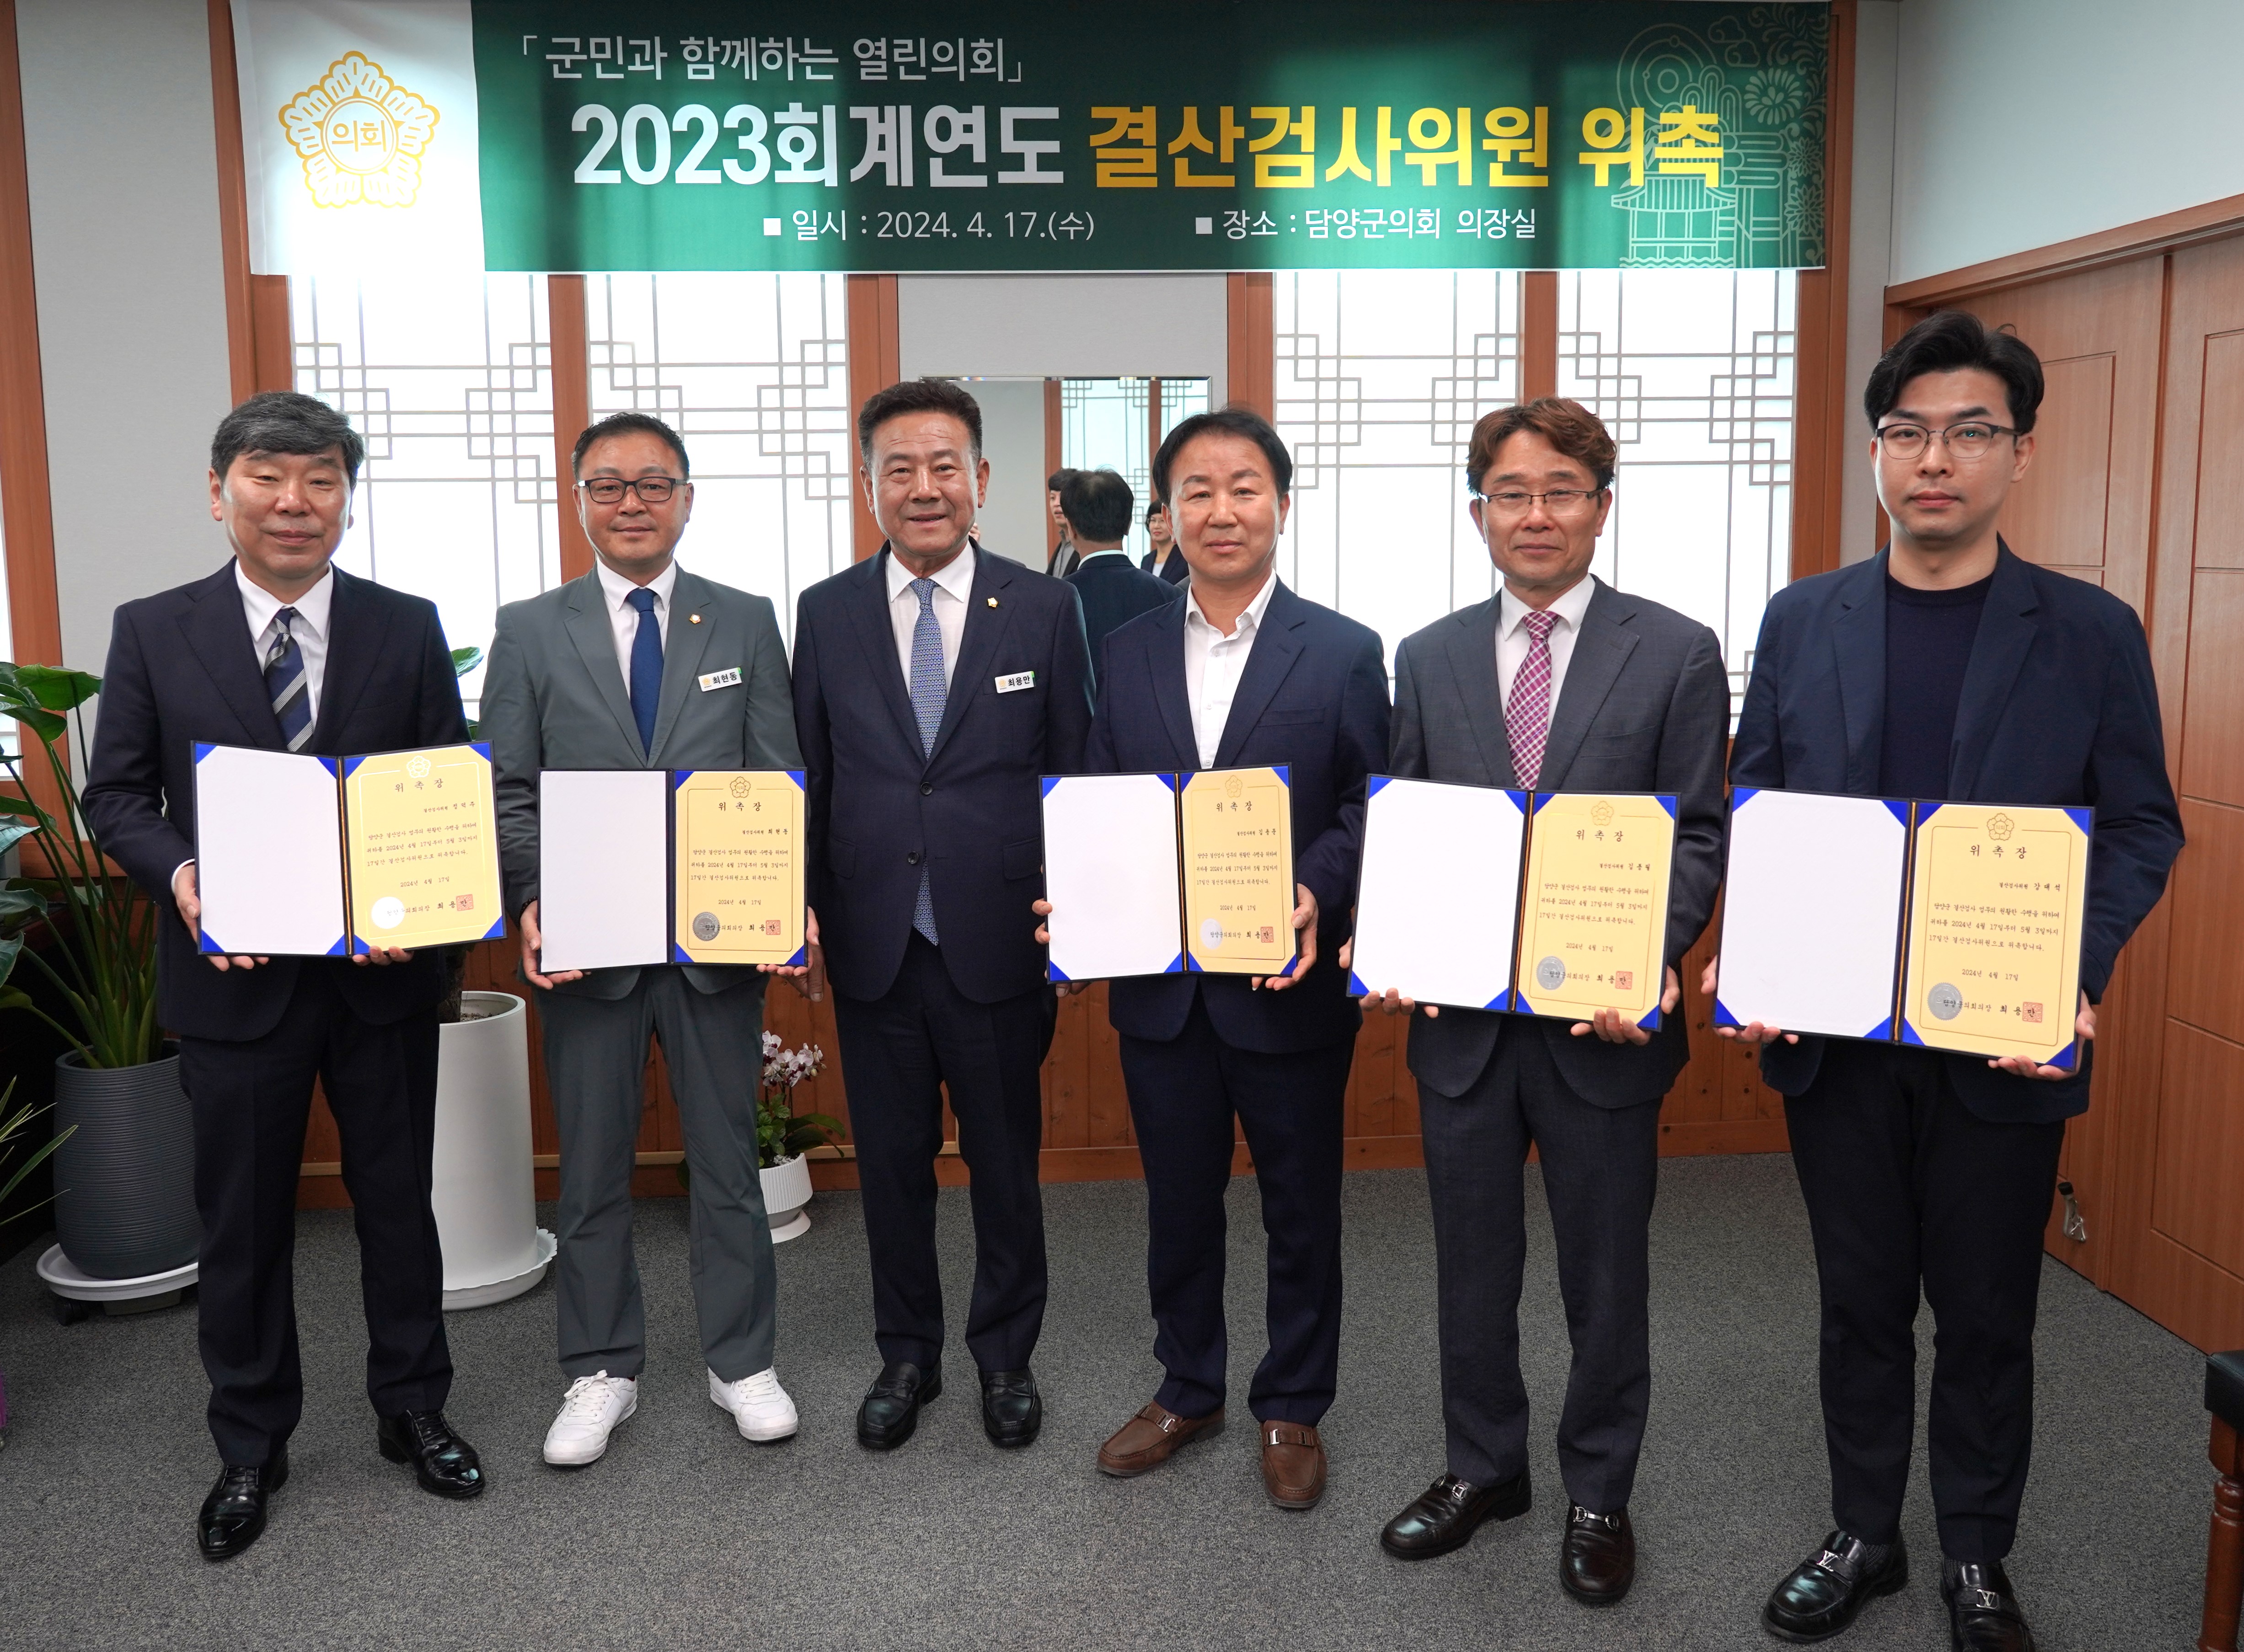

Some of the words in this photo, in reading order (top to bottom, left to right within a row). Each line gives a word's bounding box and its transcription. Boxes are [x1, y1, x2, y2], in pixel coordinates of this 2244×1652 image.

[680, 36, 839, 81] 함께하는
[332, 121, 387, 152] 의회
[572, 102, 1065, 187] 2023회계연도
[1089, 105, 1549, 189] 결산검사위원
[1580, 105, 1724, 188] 위촉
[792, 209, 847, 242] 일시
[877, 211, 958, 238] 2024.
[966, 211, 992, 238] 4.
[1004, 211, 1095, 242] 17.(수)
[1222, 209, 1279, 241] 장소
[1304, 208, 1441, 241] 담양군의회
[1457, 207, 1536, 240] 의장실
[712, 672, 737, 684] 최현동
[1008, 675, 1030, 687] 최용만
